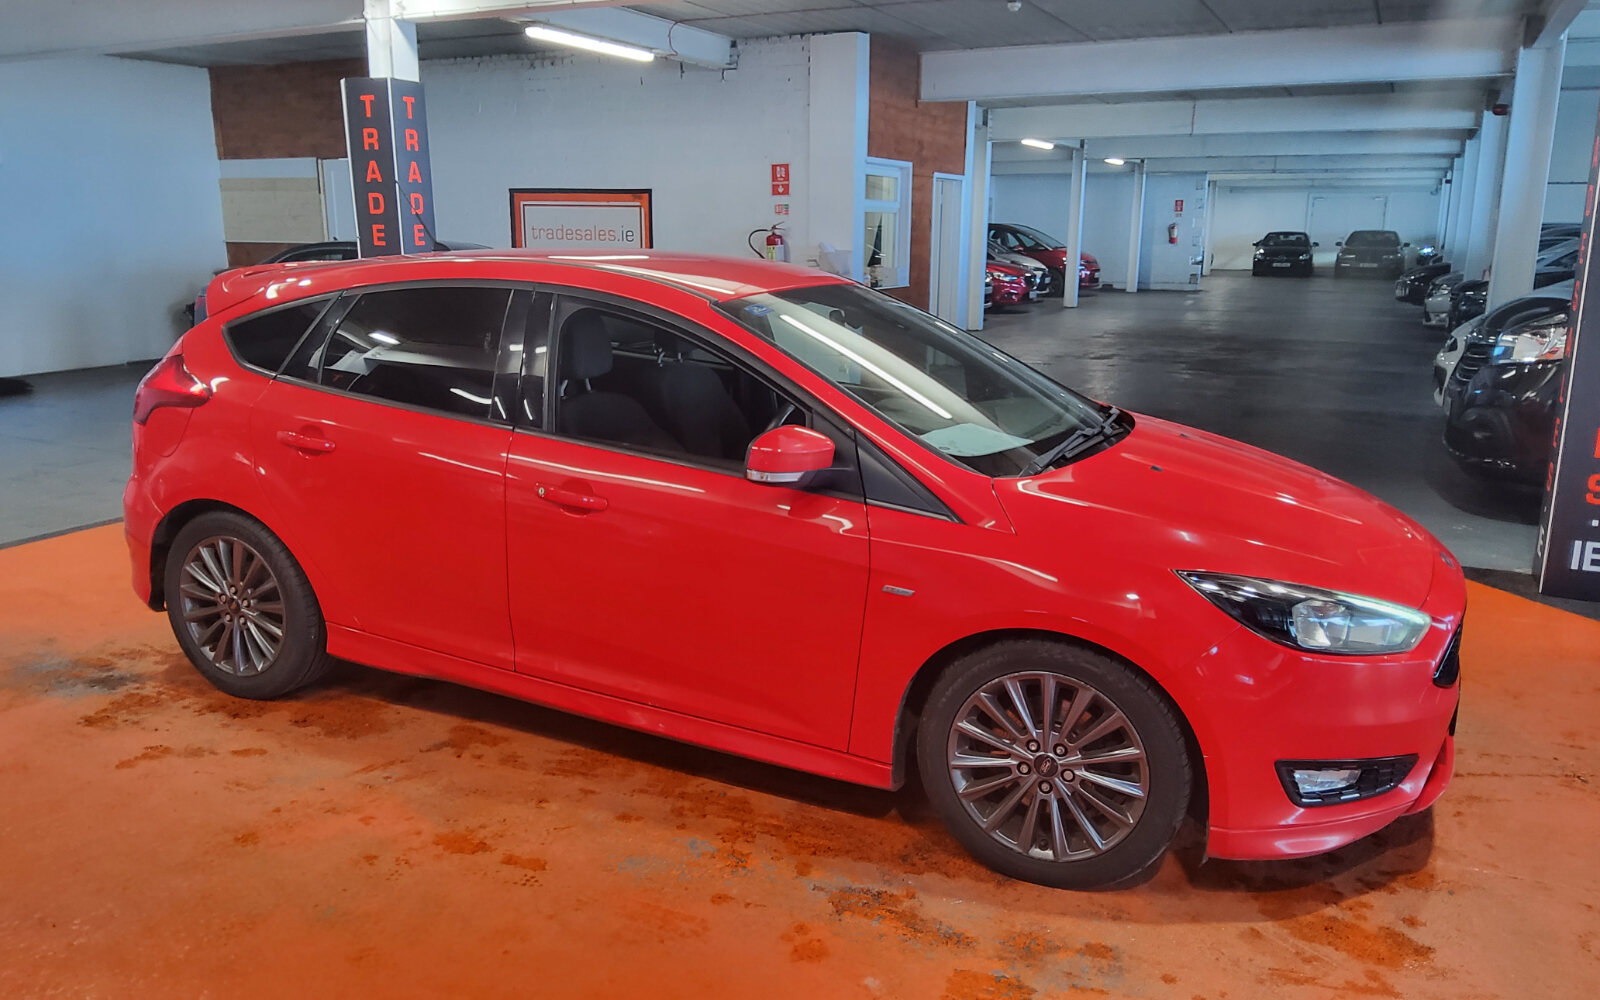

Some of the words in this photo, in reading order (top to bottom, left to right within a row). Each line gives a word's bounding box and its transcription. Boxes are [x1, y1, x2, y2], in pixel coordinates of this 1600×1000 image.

[360, 94, 386, 246] TRADE
[403, 96, 426, 246] TRADE
[531, 225, 635, 243] tradesales.ie
